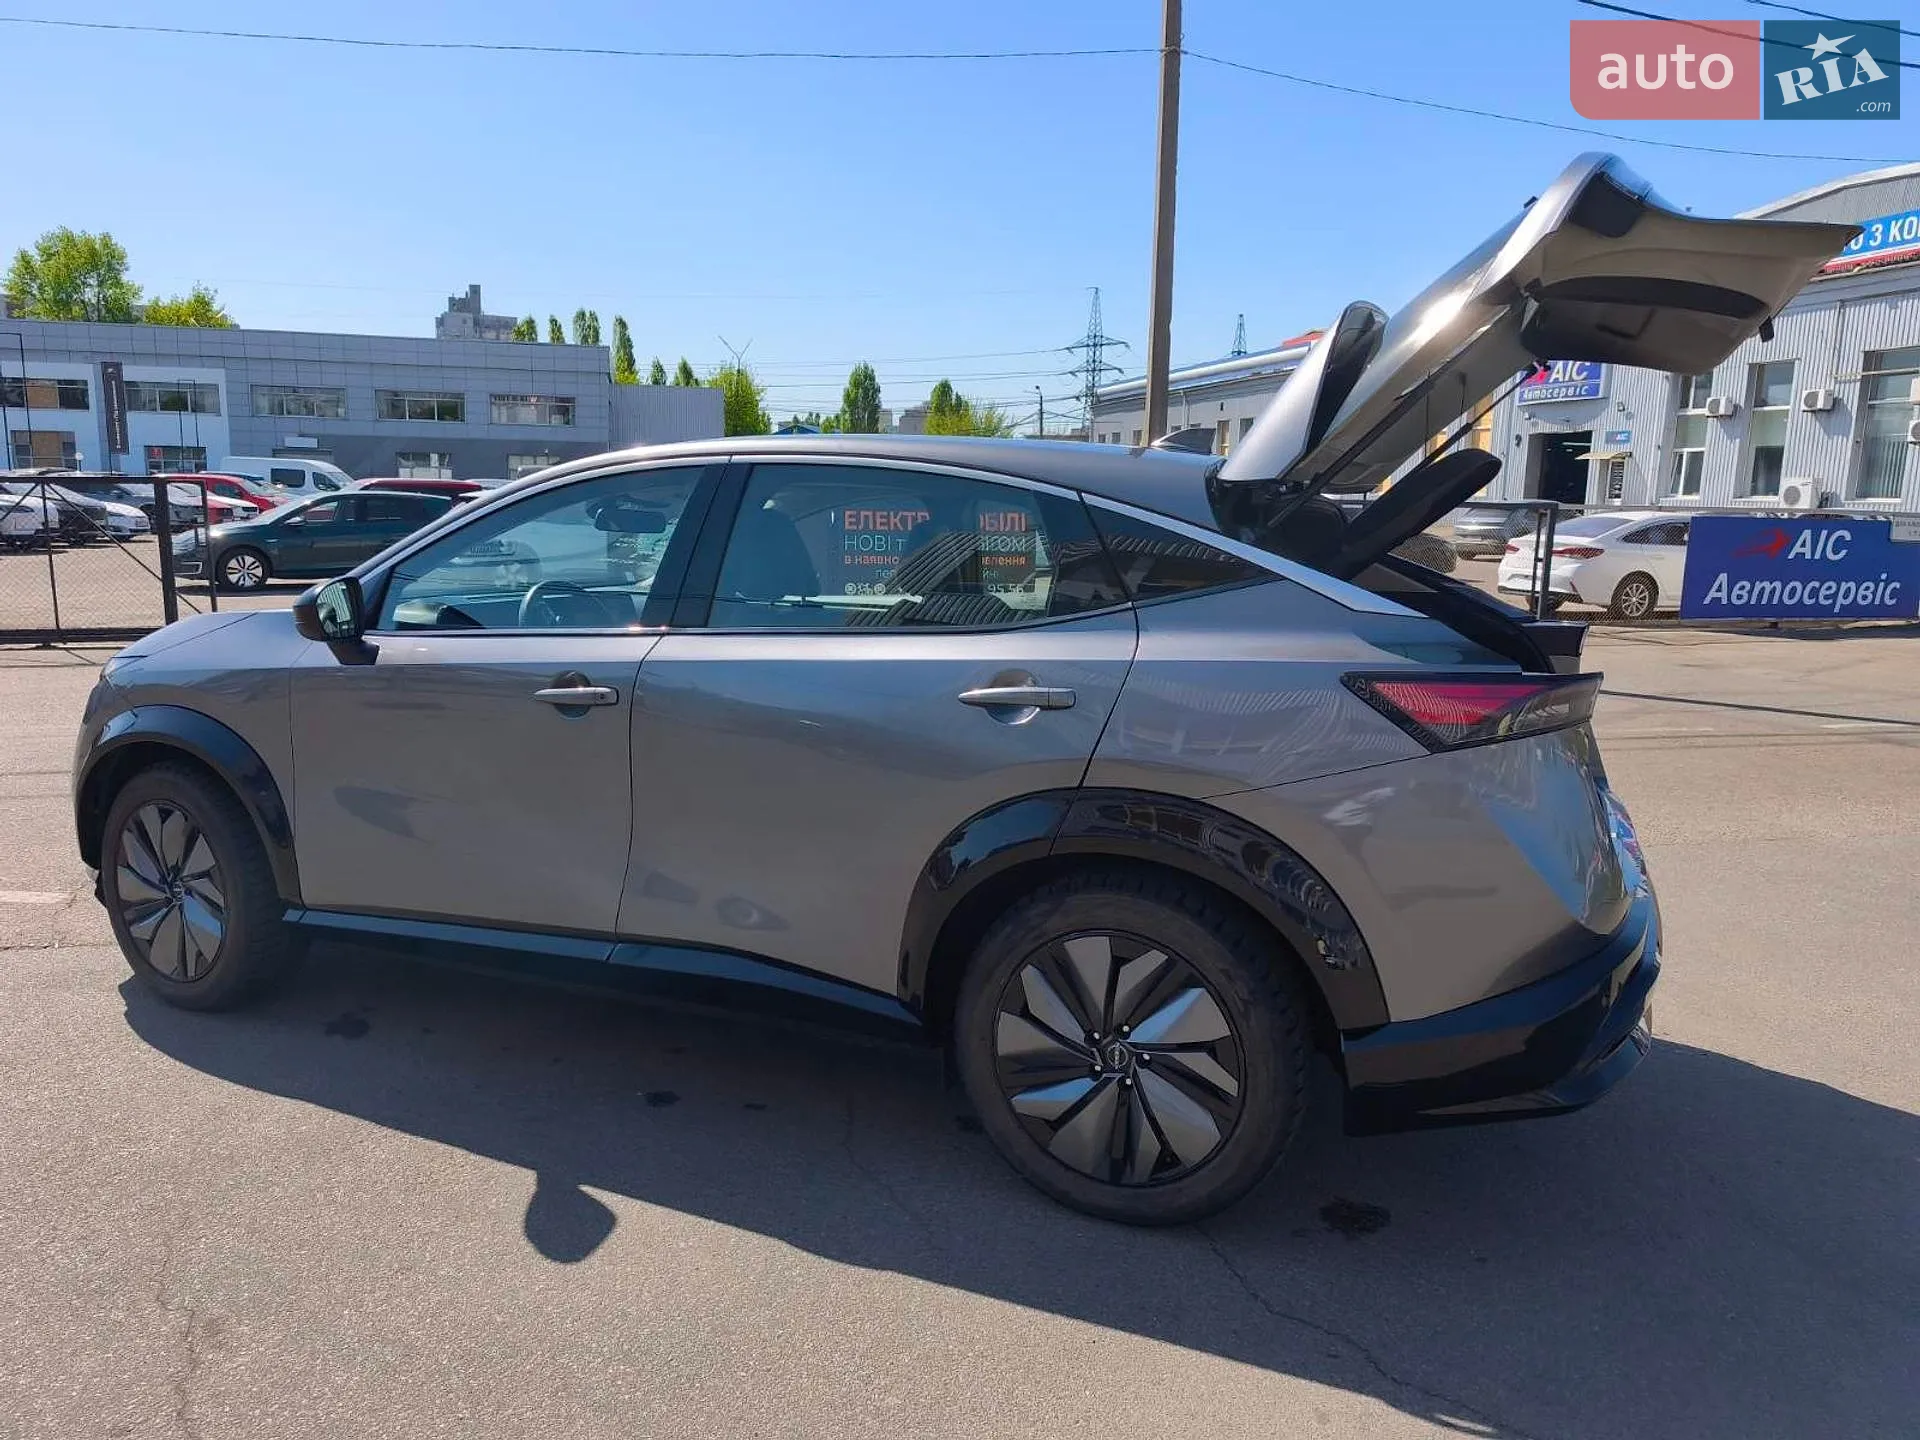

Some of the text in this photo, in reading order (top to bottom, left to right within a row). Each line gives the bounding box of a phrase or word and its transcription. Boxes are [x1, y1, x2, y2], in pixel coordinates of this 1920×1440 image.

[1888, 215, 1920, 243] КО
[844, 535, 891, 551] НОВІ
[855, 555, 900, 565] наявно
[1703, 572, 1901, 613] Автосервіс
